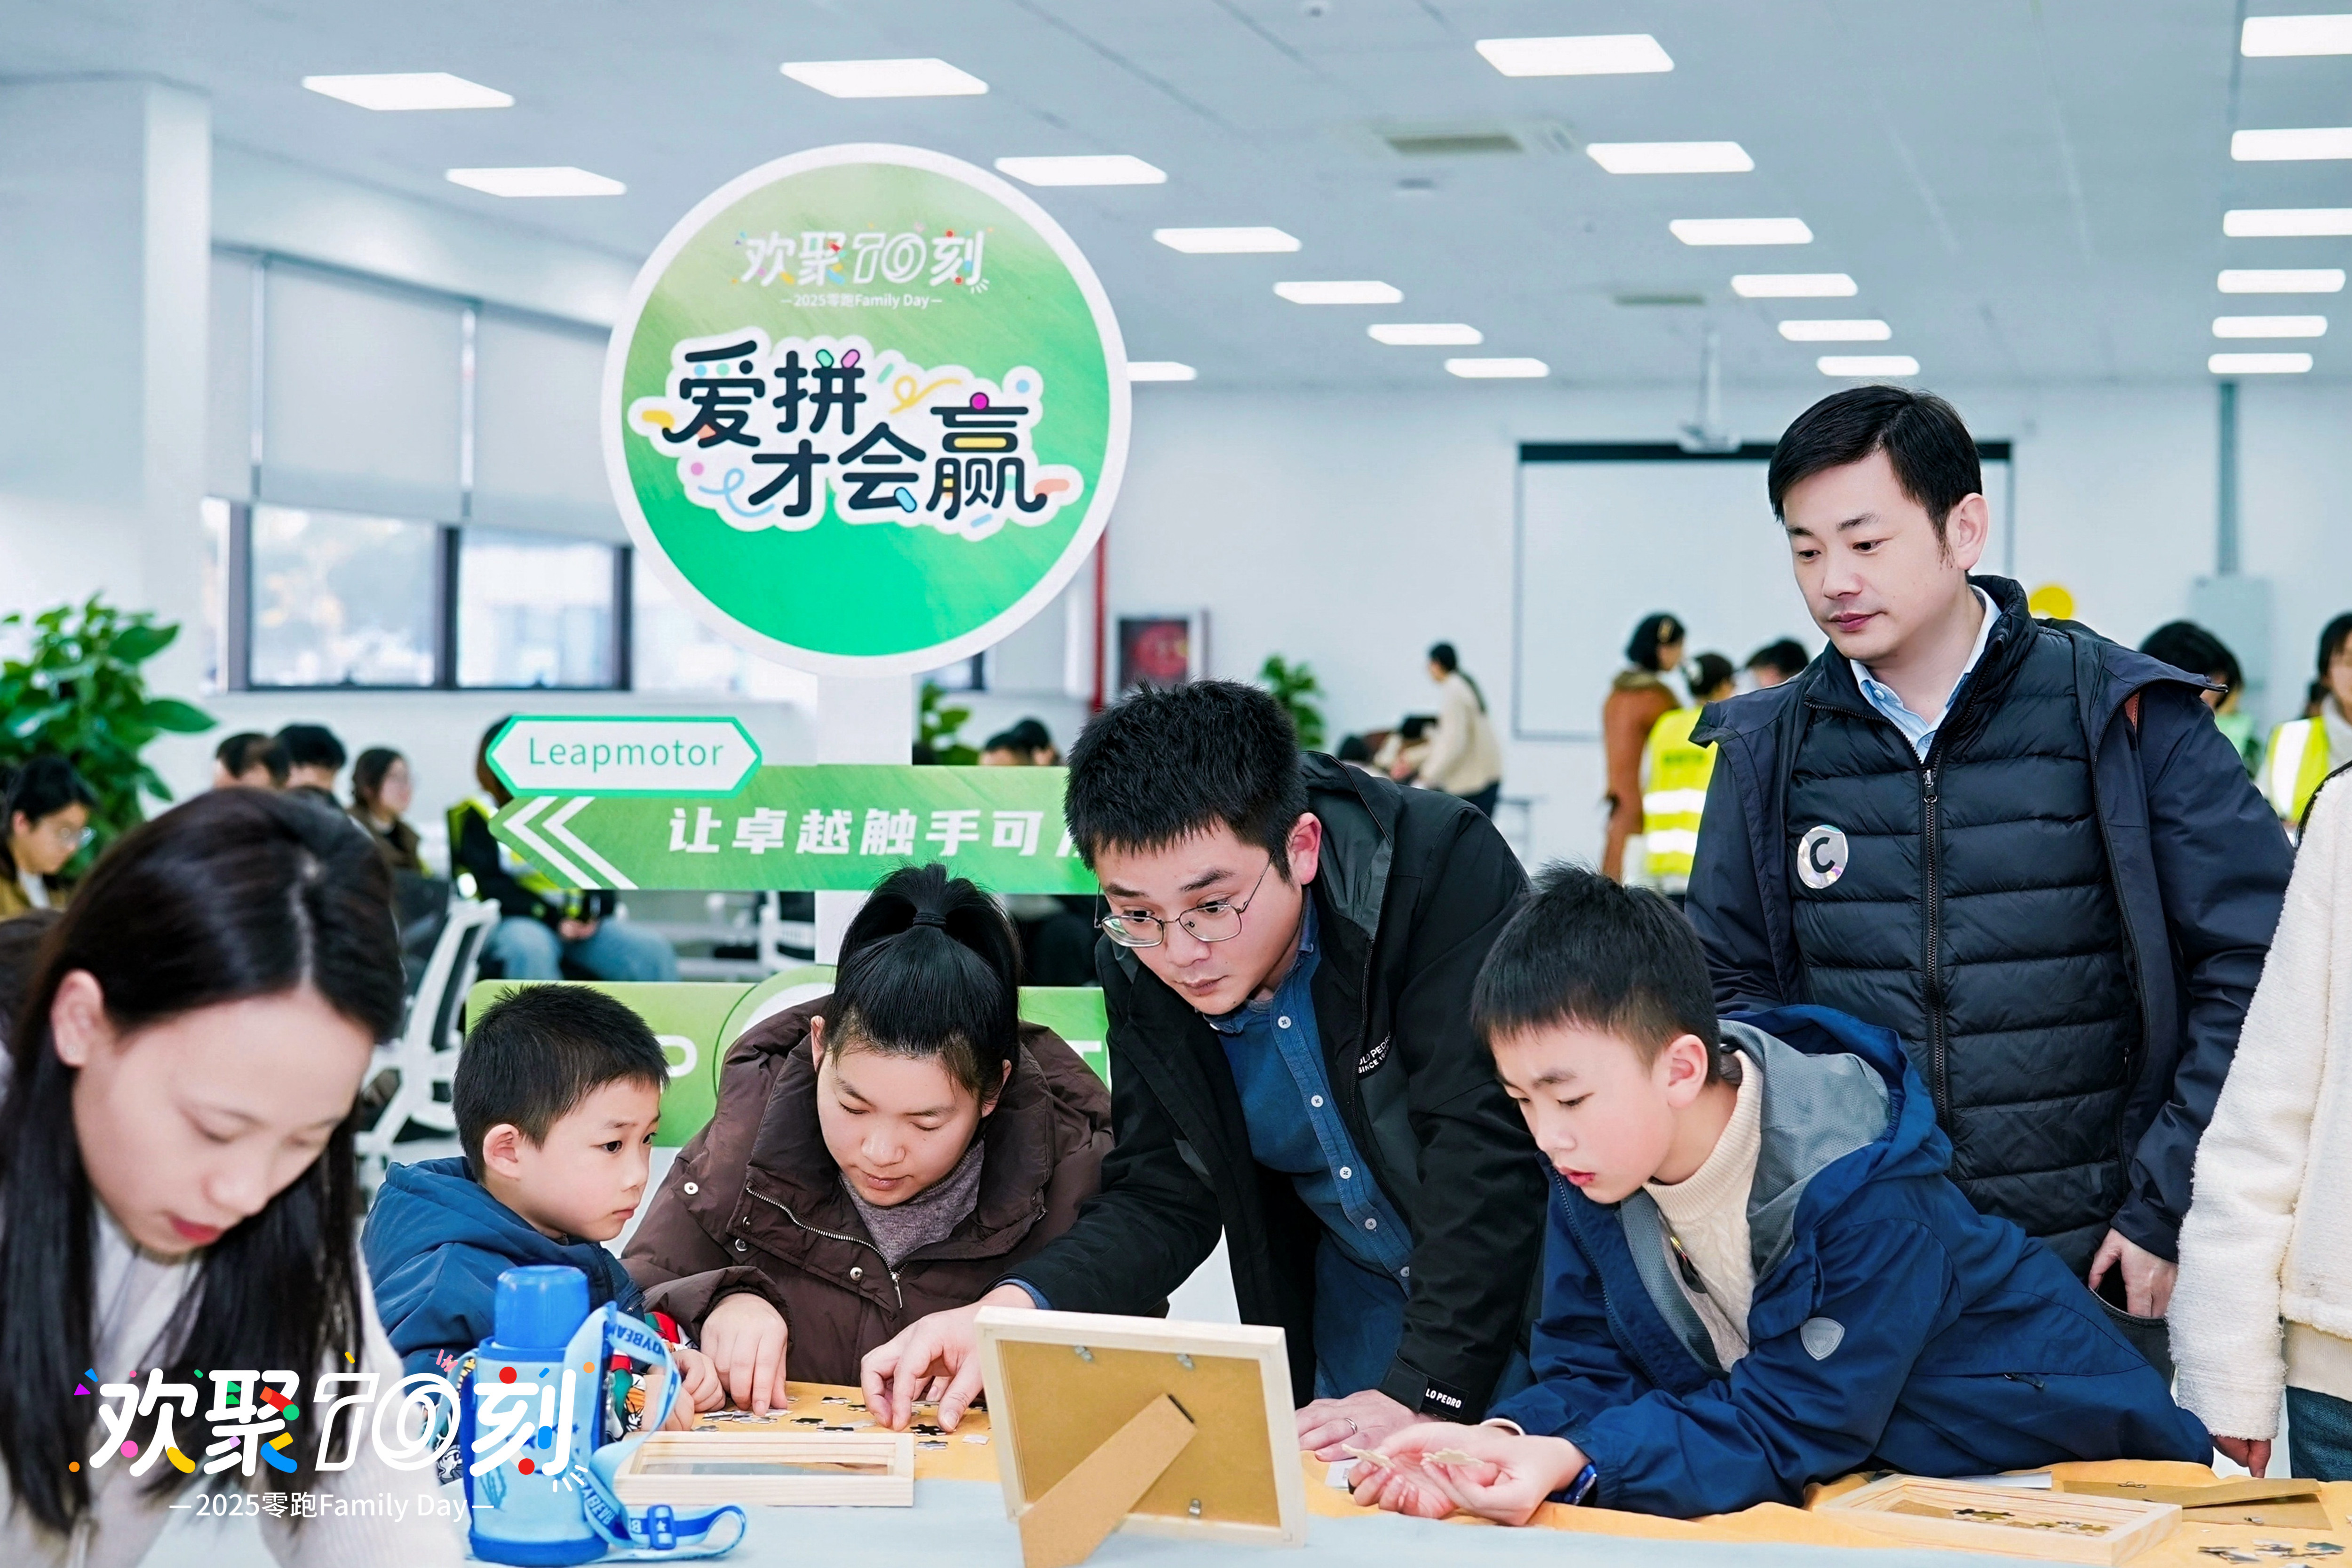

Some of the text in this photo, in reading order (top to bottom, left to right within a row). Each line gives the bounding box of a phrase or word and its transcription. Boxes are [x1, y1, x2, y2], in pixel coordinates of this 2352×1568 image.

[903, 293, 930, 309] Day
[662, 340, 866, 448] 爱拼
[748, 392, 1048, 520] 才会赢
[530, 736, 723, 773] Leapmotor
[1810, 837, 1836, 873] C
[1358, 1059, 1379, 1073] SINCE
[1436, 1392, 1462, 1408] PEDRO
